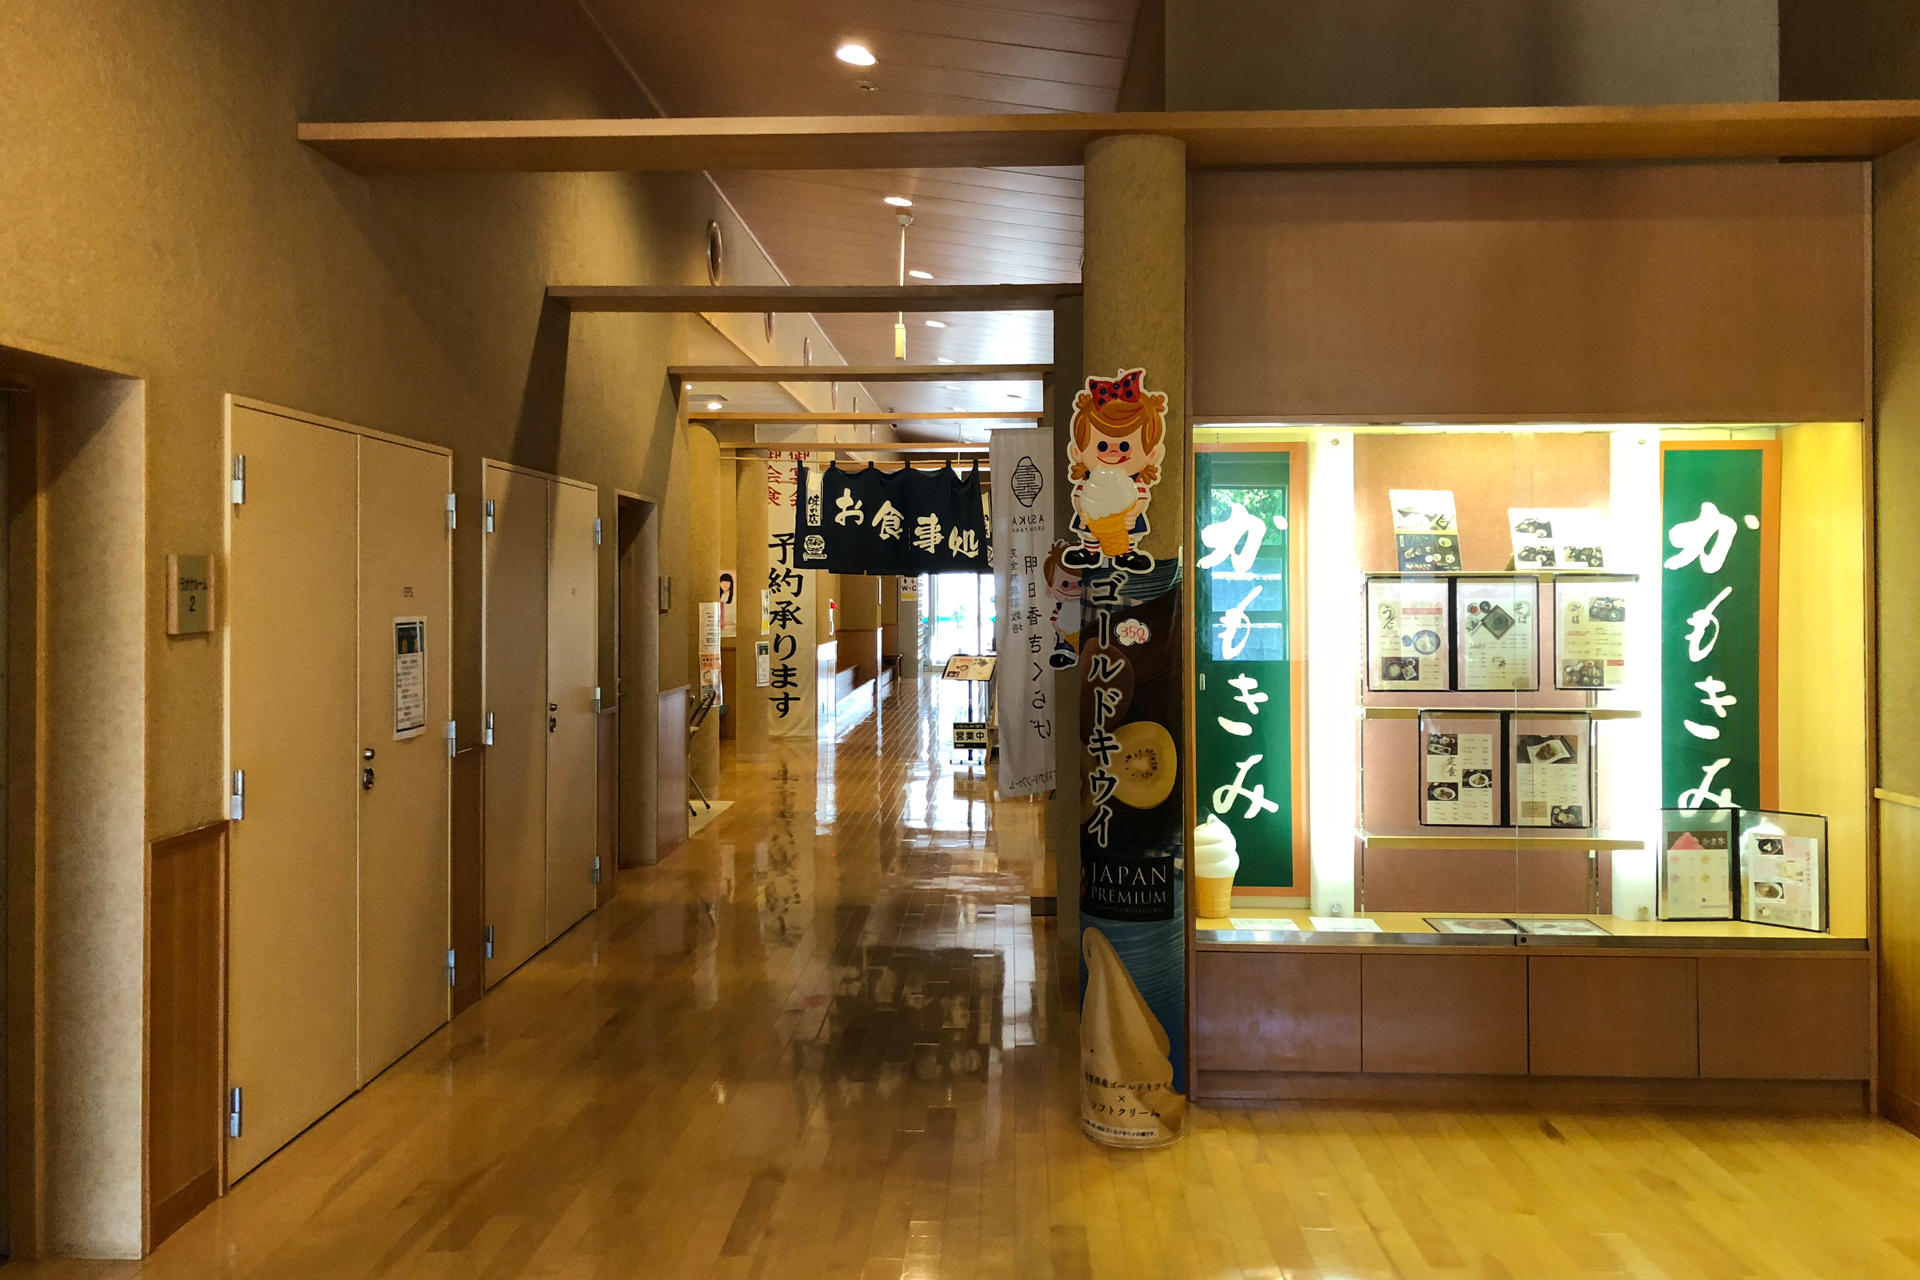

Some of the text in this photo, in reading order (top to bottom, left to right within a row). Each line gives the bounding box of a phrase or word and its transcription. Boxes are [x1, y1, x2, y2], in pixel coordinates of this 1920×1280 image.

[808, 494, 820, 525] 味の店
[834, 487, 980, 559] お食事処
[189, 595, 196, 612] 2
[768, 532, 804, 719] 予約承ります
[1196, 502, 1289, 819] かもきみ
[1663, 502, 1760, 823] かもきみ
[1088, 571, 1127, 848] ゴールドキウイ
[956, 731, 985, 741] 営業中
[1446, 756, 1458, 777] 定食
[1092, 862, 1167, 886] JAPAN
[1091, 885, 1167, 905] PREMIUM
